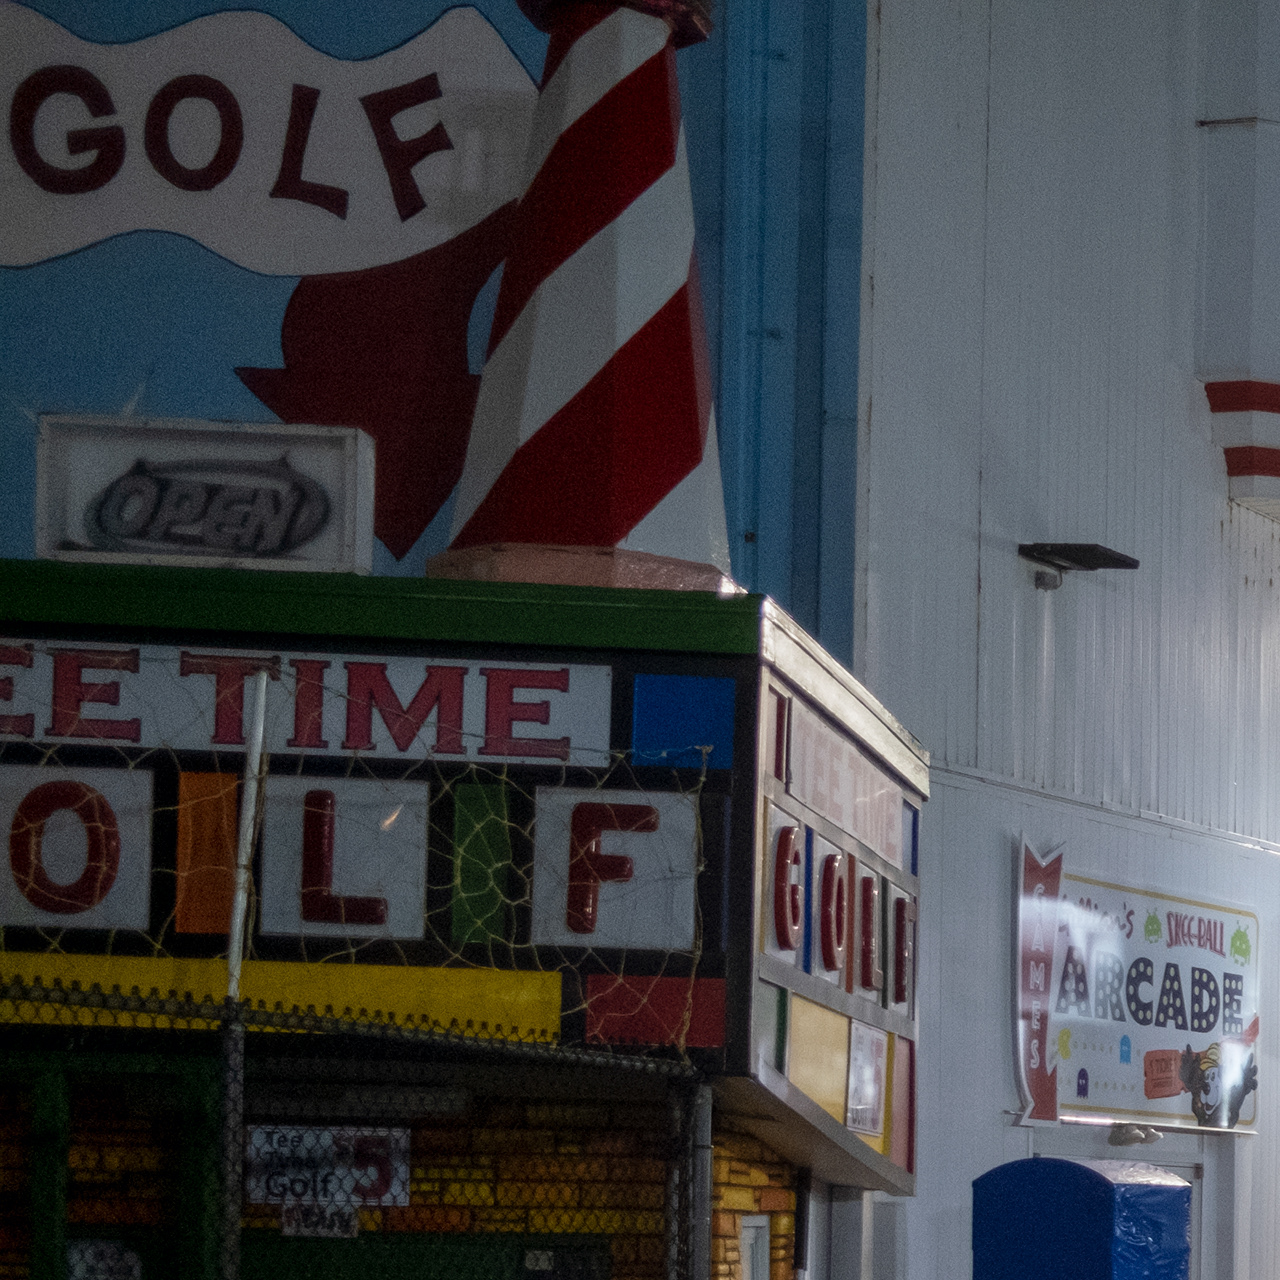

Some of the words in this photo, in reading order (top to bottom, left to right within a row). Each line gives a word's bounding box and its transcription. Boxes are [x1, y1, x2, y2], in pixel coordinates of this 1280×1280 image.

[8, 64, 455, 223] GOLF
[97, 477, 307, 556] OPEN
[180, 651, 571, 761] TIME
[774, 826, 916, 1003] GOLF
[1054, 945, 1244, 1036] ARCADE
[266, 1172, 336, 1198] Golf
